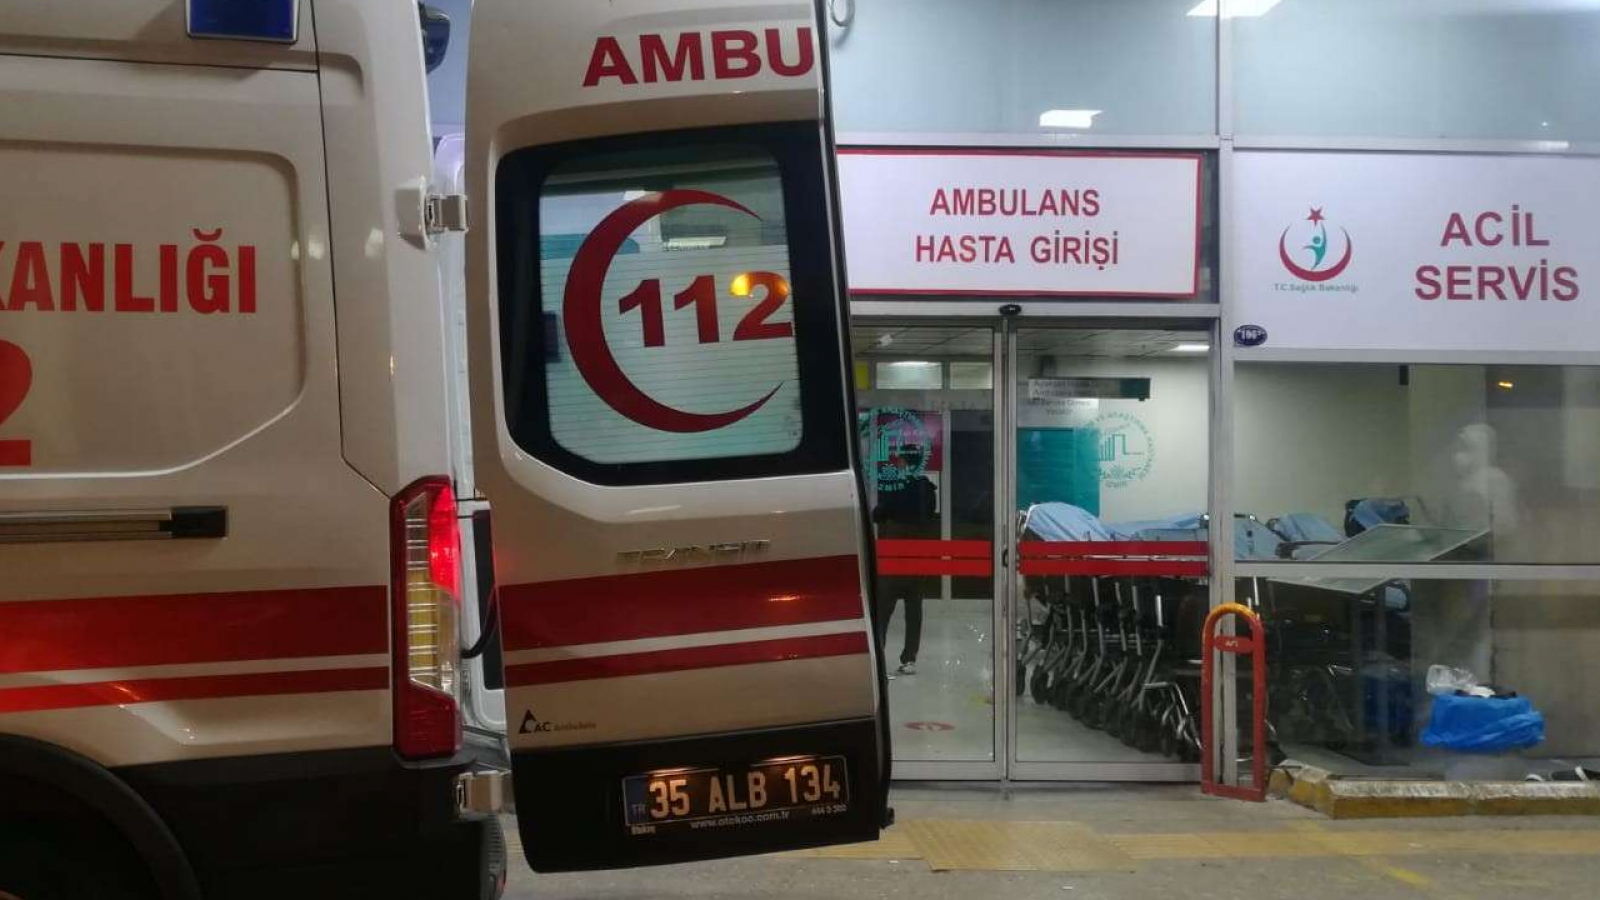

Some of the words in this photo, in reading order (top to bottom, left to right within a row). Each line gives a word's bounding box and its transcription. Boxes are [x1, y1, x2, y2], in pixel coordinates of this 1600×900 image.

[582, 27, 815, 87] AMBU
[930, 188, 1100, 217] AMBULANS
[1440, 203, 1550, 247] ACİL
[0, 227, 257, 315] ANLIĞI
[915, 234, 1015, 264] HASTA
[1030, 229, 1119, 270] GİRİŞİ
[1415, 258, 1580, 302] SERVİS
[618, 270, 794, 348] 112
[649, 778, 690, 819] 35
[709, 771, 768, 813] ALB
[785, 762, 841, 804] 134
